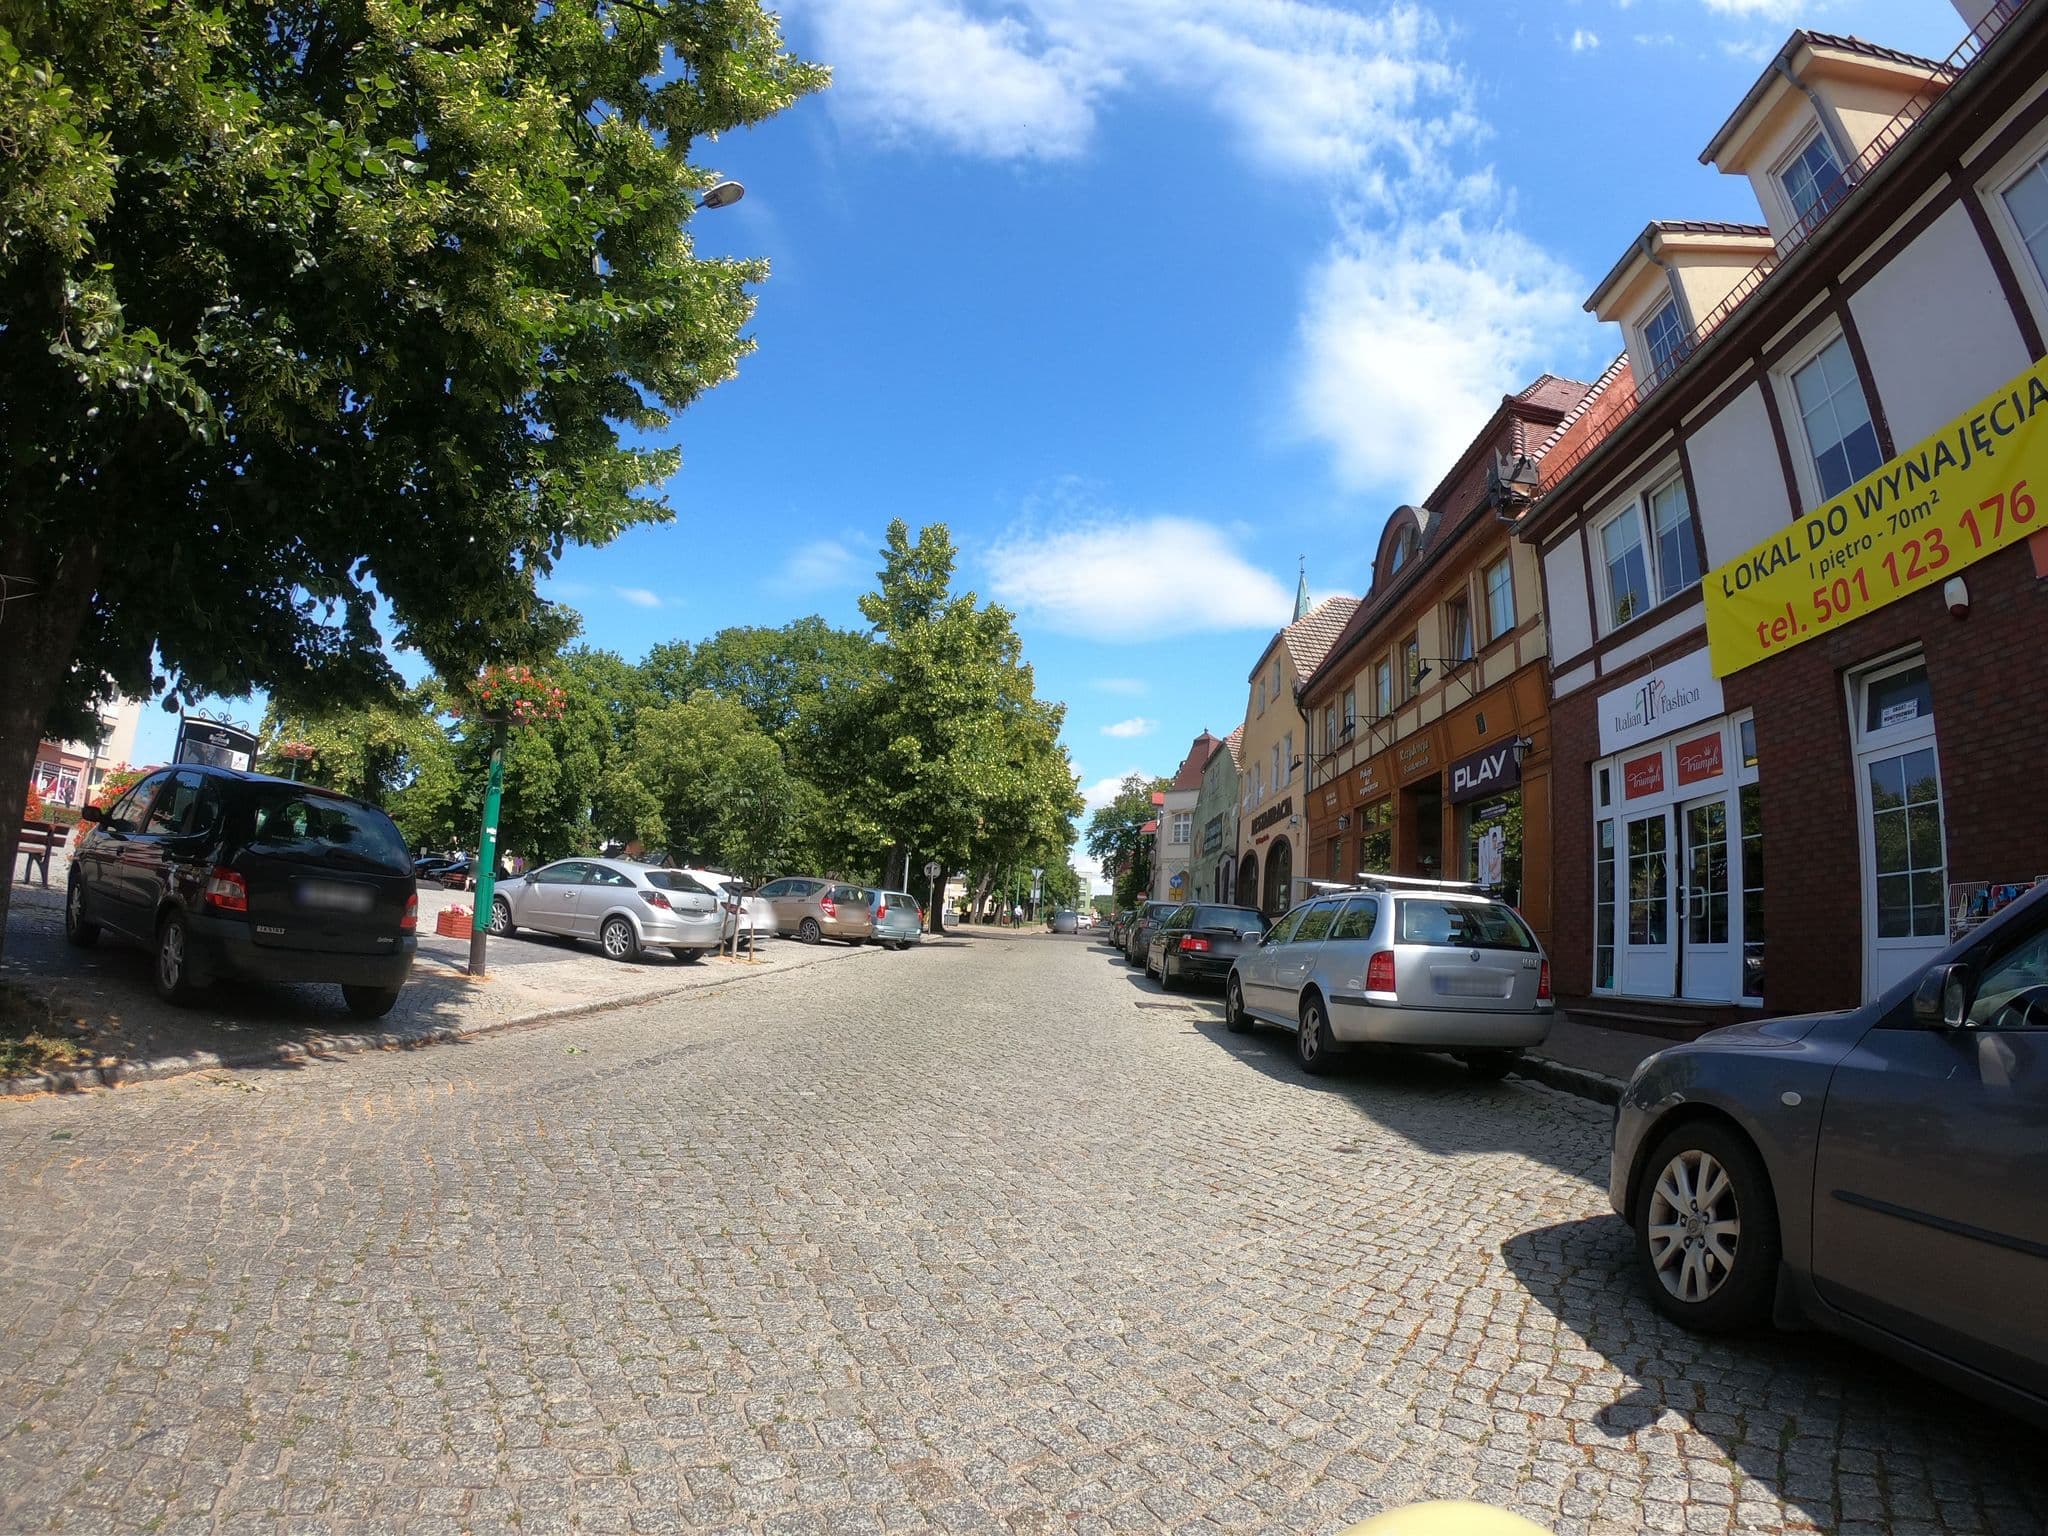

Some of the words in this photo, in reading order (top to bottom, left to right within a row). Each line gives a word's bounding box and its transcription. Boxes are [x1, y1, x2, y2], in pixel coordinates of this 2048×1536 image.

[1722, 536, 1801, 599] LOKAL
[1806, 505, 1848, 550] DO
[1853, 376, 2048, 519] WYNAJĘCIA
[1756, 601, 1808, 649] tel.
[1813, 566, 1870, 624] 501
[1881, 527, 1950, 588] 123
[1958, 479, 2036, 549] 176
[1819, 534, 1873, 580] piętro
[1615, 712, 1642, 733] Italian
[1661, 686, 1700, 714] Fashion
[1454, 749, 1507, 793] PLAY
[1627, 766, 1661, 789] Triumph
[1680, 746, 1719, 773] Triumph
